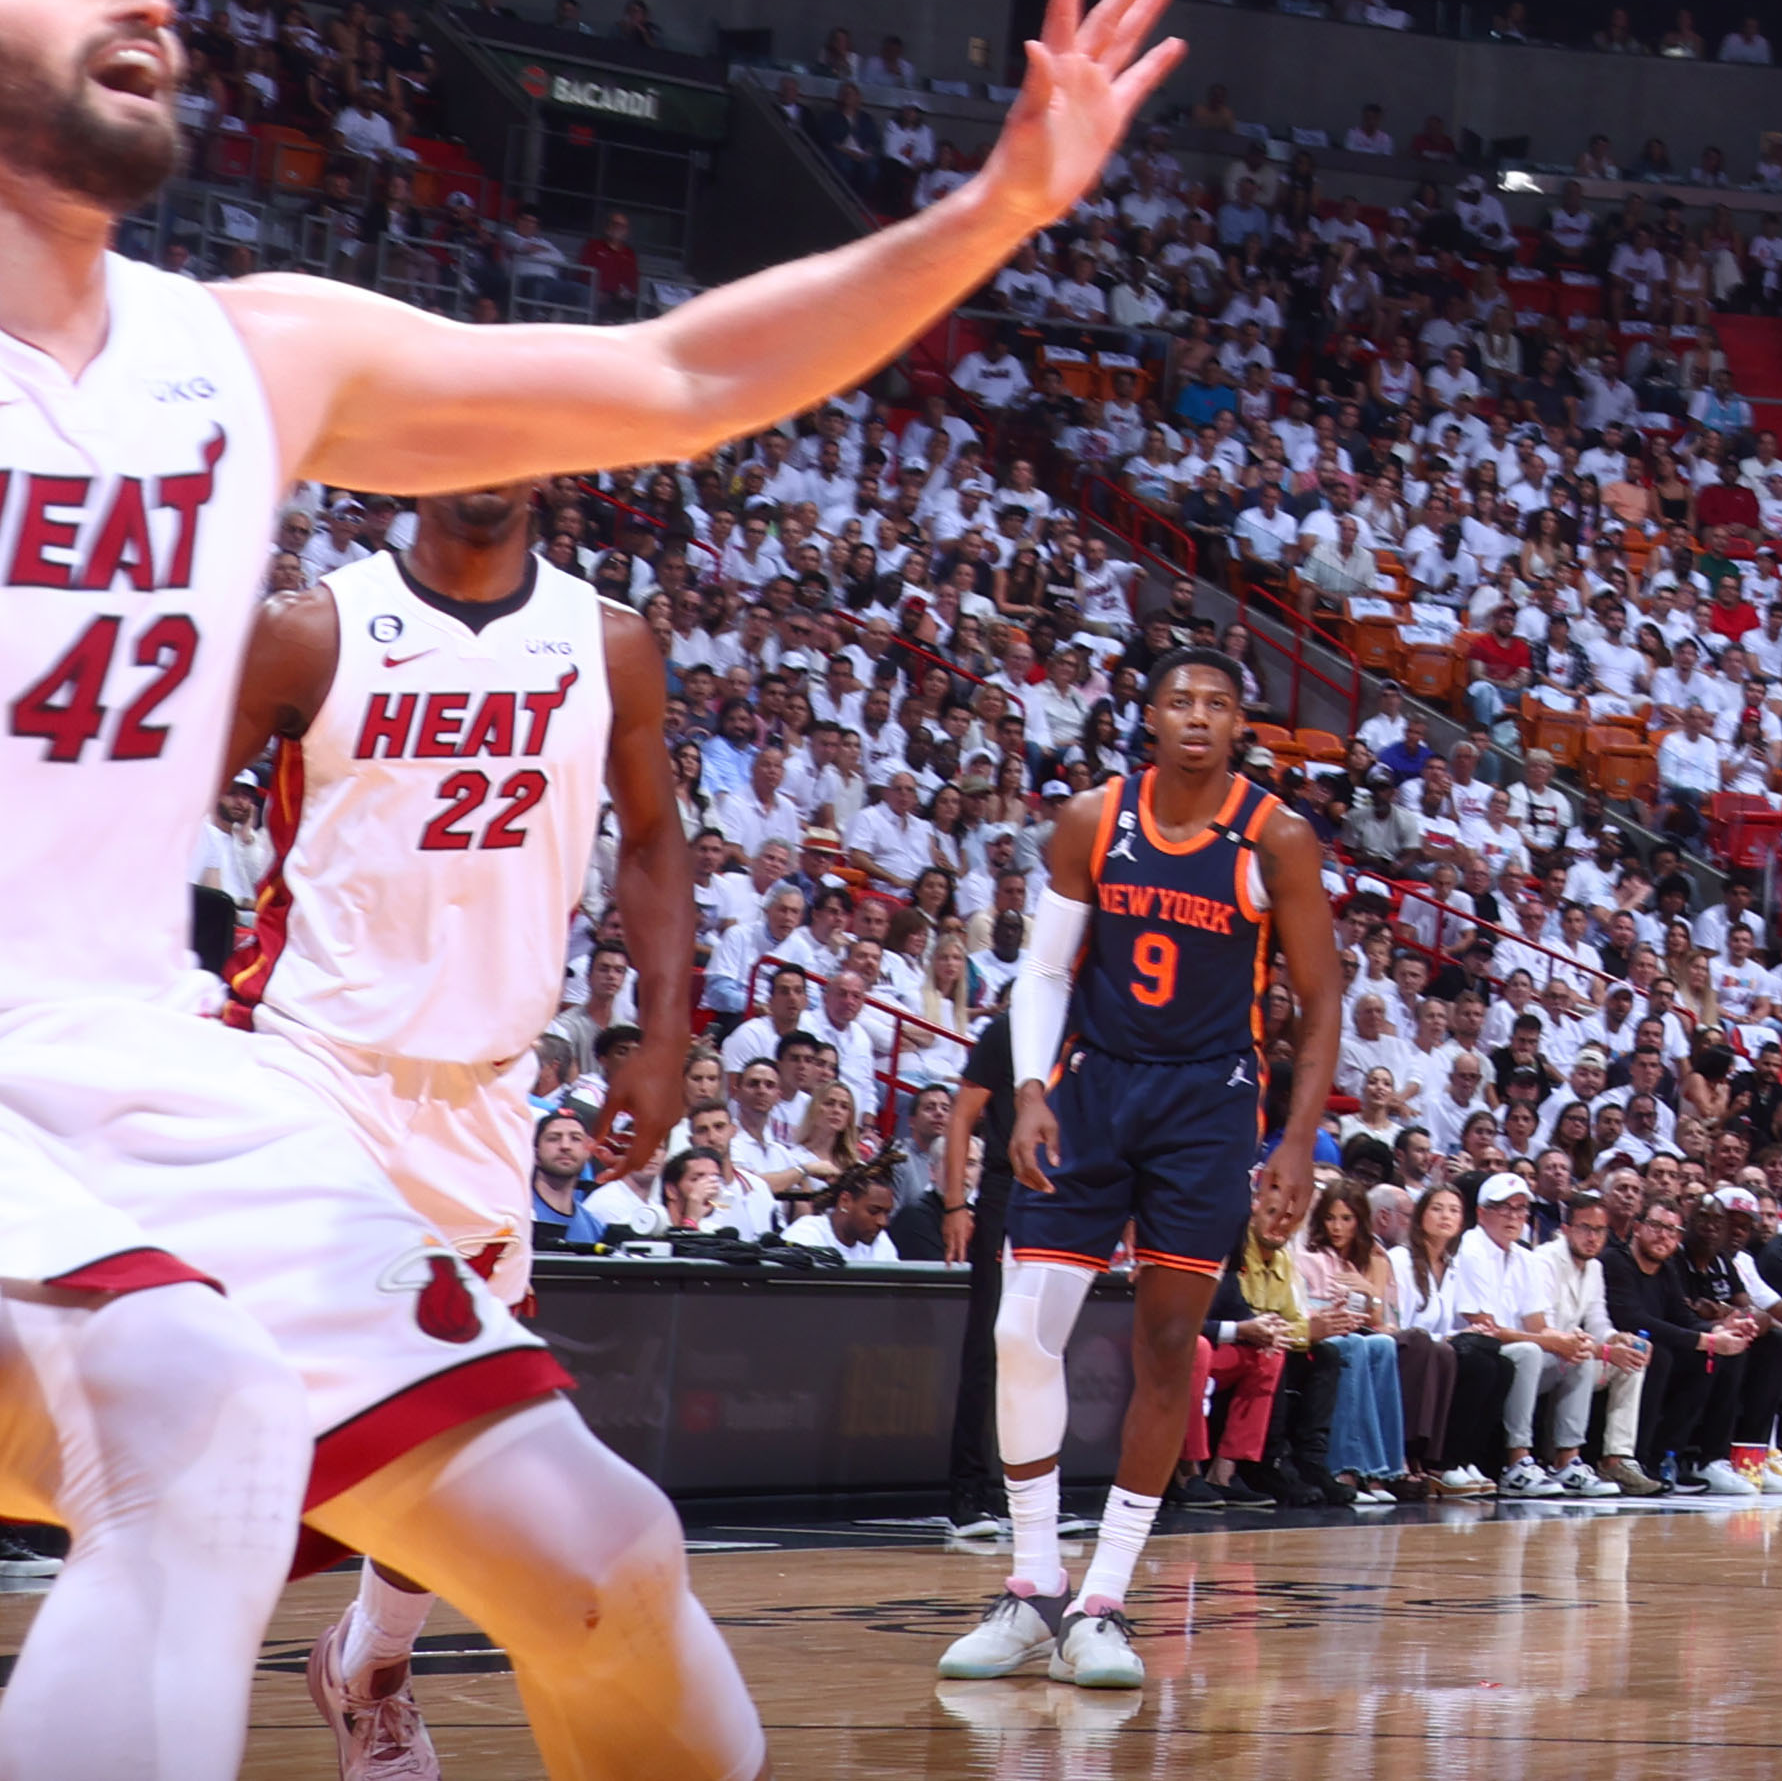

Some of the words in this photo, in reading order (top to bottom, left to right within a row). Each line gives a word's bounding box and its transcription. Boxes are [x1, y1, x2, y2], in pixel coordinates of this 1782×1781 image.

[147, 376, 218, 404] UKG
[523, 638, 574, 657] UKG
[9, 613, 199, 763] 42
[353, 663, 579, 760] HEAT
[417, 768, 549, 851] 22
[1097, 882, 1156, 919] NEW
[1157, 887, 1237, 936] YORK
[1129, 931, 1180, 1008] 9
